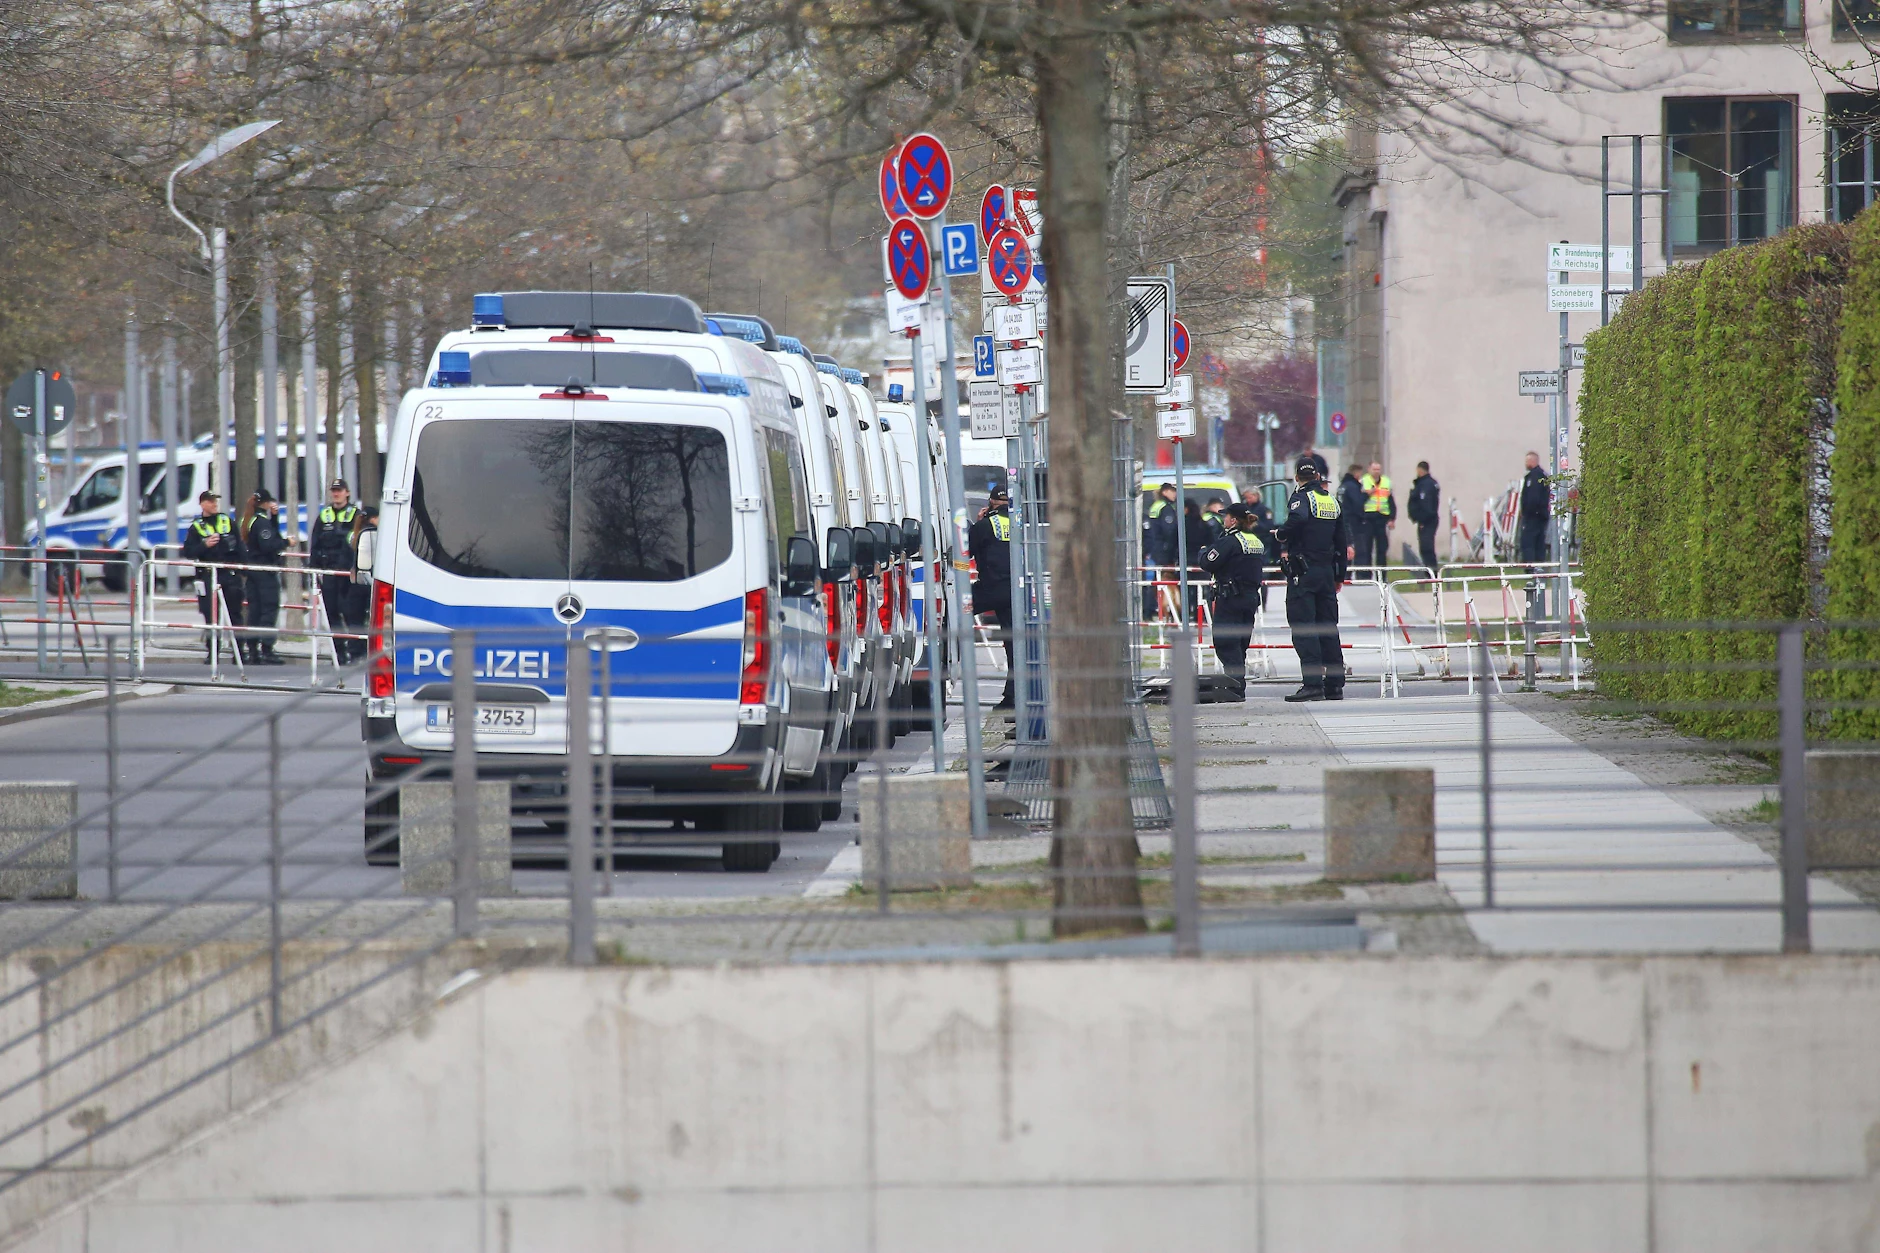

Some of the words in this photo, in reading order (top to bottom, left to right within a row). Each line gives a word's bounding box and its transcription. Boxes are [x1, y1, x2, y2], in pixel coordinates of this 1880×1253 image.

[1565, 248, 1603, 259] Brandenburge
[1564, 259, 1599, 271] Reichstag
[1551, 288, 1593, 298] Schöneberg
[1551, 299, 1594, 309] Siegessäule
[424, 405, 443, 419] 22
[1318, 502, 1335, 510] POLIZEI
[413, 648, 549, 678] POIZEI
[481, 708, 525, 726] 3753
